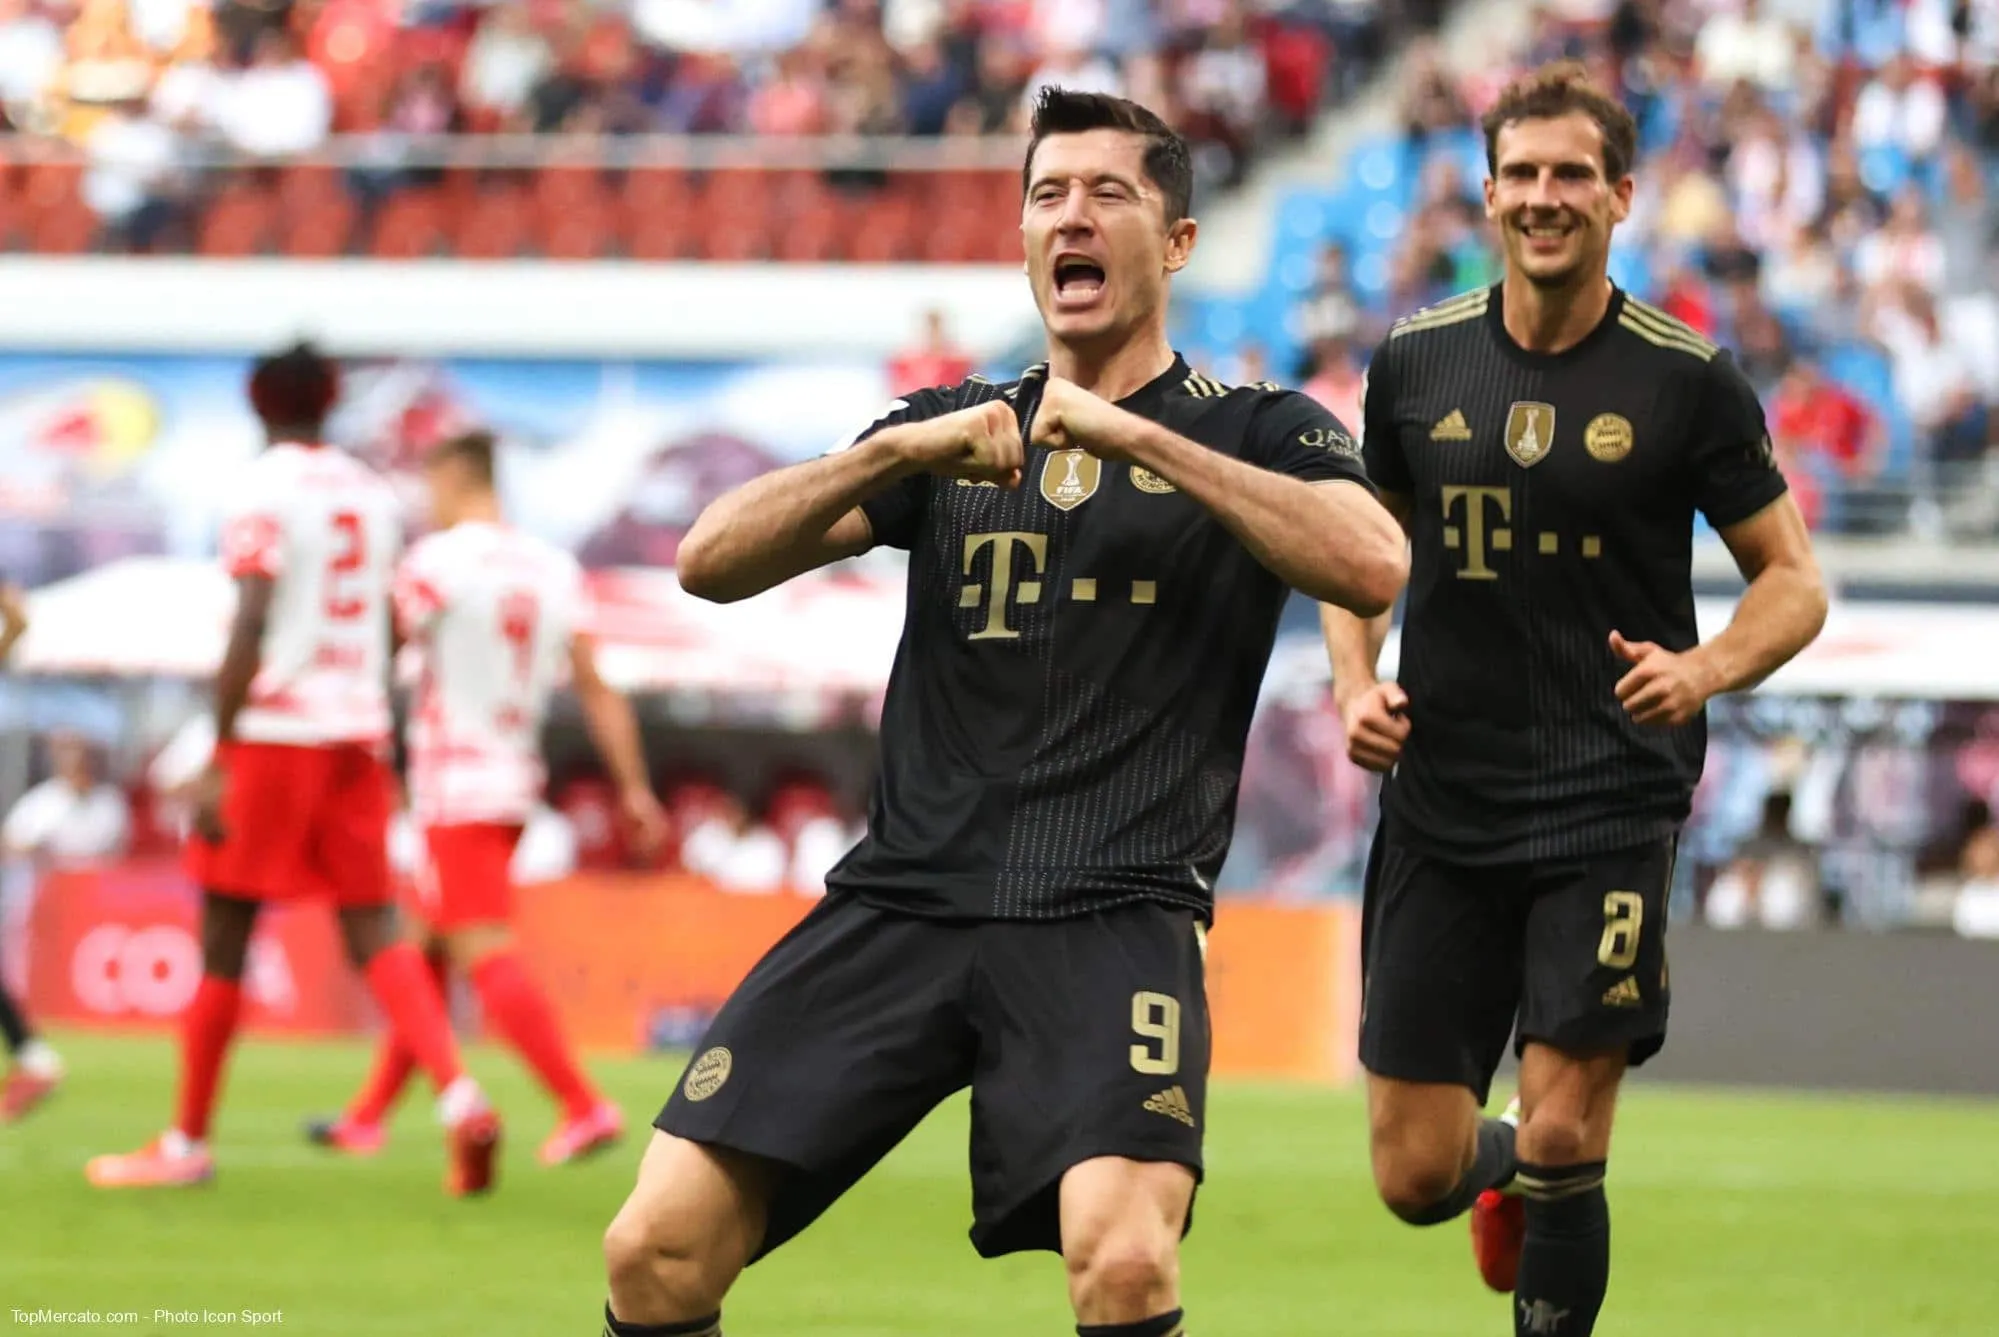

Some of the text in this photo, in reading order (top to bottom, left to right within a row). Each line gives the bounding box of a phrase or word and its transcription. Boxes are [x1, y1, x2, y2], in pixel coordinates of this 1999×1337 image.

[1056, 486, 1084, 495] FIFA
[1597, 890, 1643, 969] 8
[1129, 989, 1180, 1075] 9
